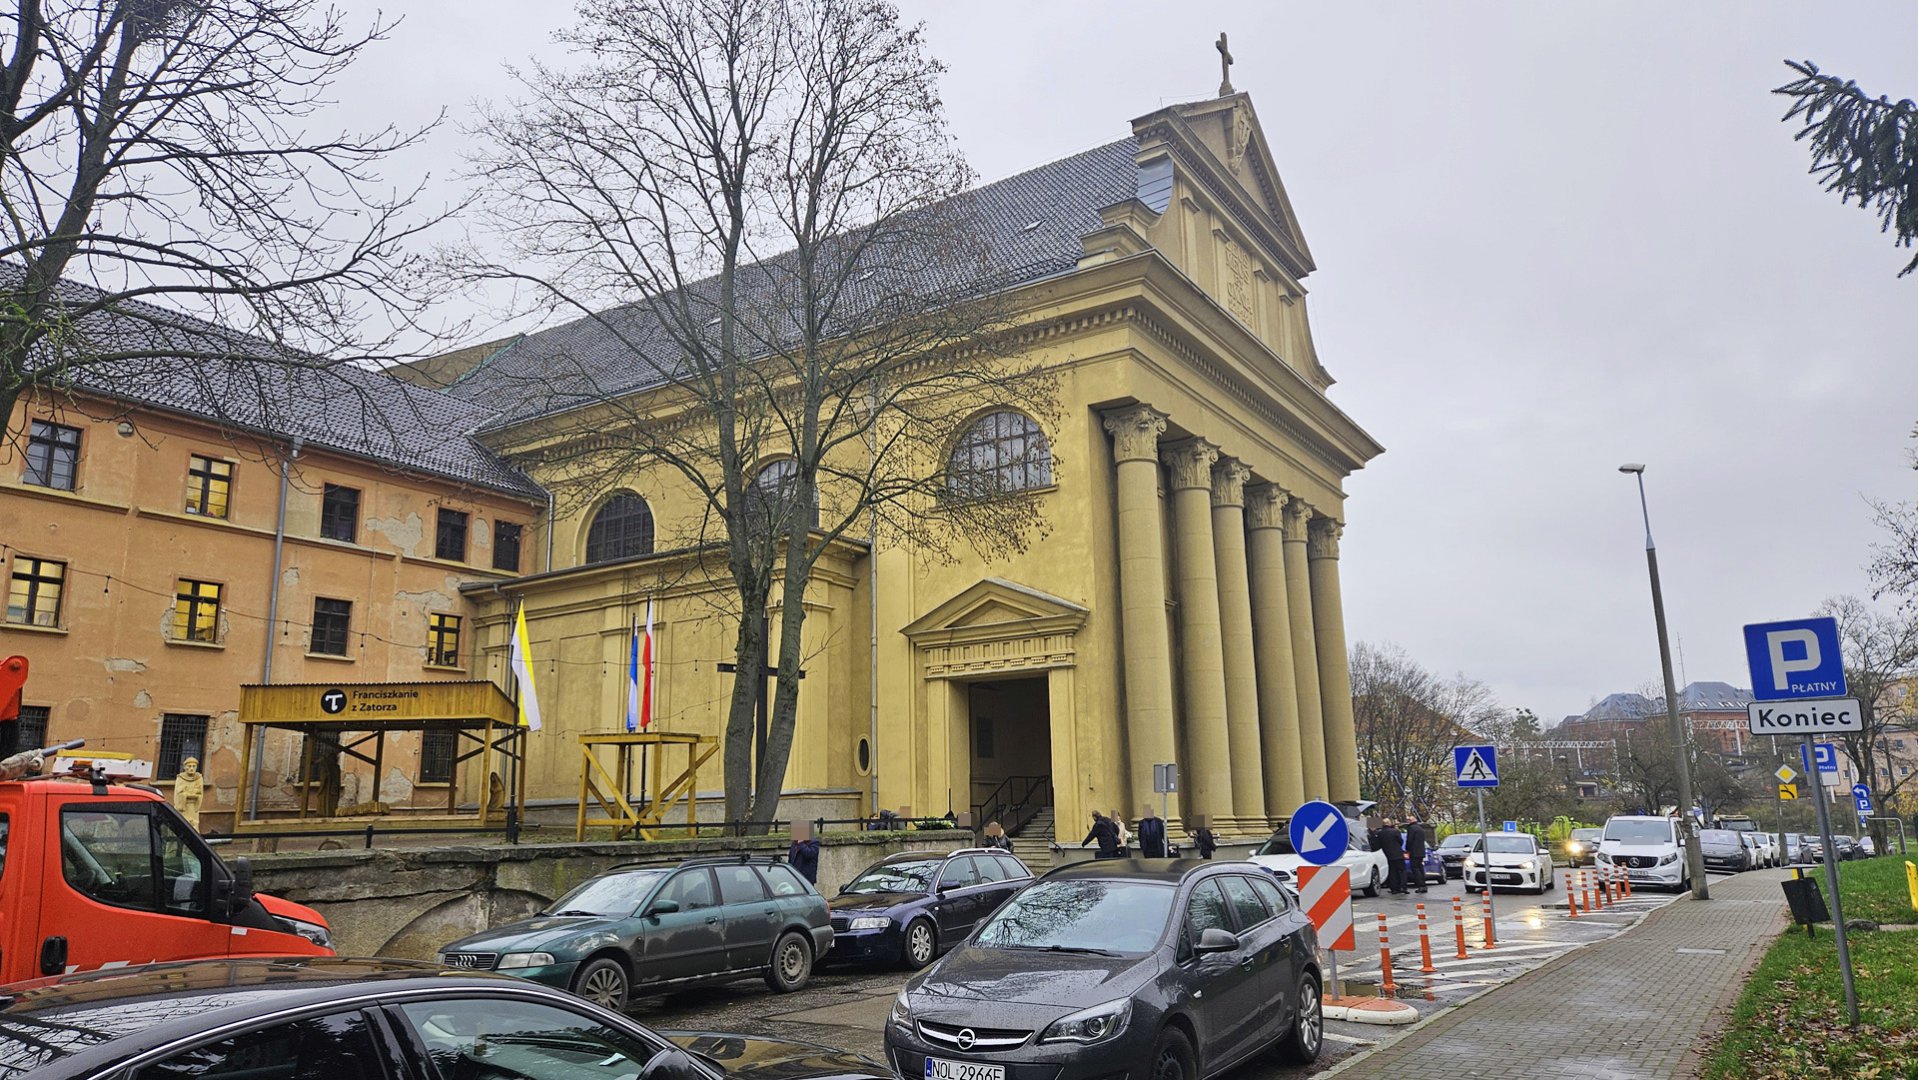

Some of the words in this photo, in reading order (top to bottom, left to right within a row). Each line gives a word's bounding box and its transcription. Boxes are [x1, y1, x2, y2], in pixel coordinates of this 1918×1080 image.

[1766, 628, 1821, 691] P
[353, 689, 419, 699] Franciszkanie
[1791, 681, 1837, 694] PŁATNY
[352, 704, 357, 712] z
[359, 702, 397, 712] Zatorza
[1758, 706, 1852, 728] Koniec
[1507, 823, 1514, 831] L
[932, 1060, 955, 1080] NOL
